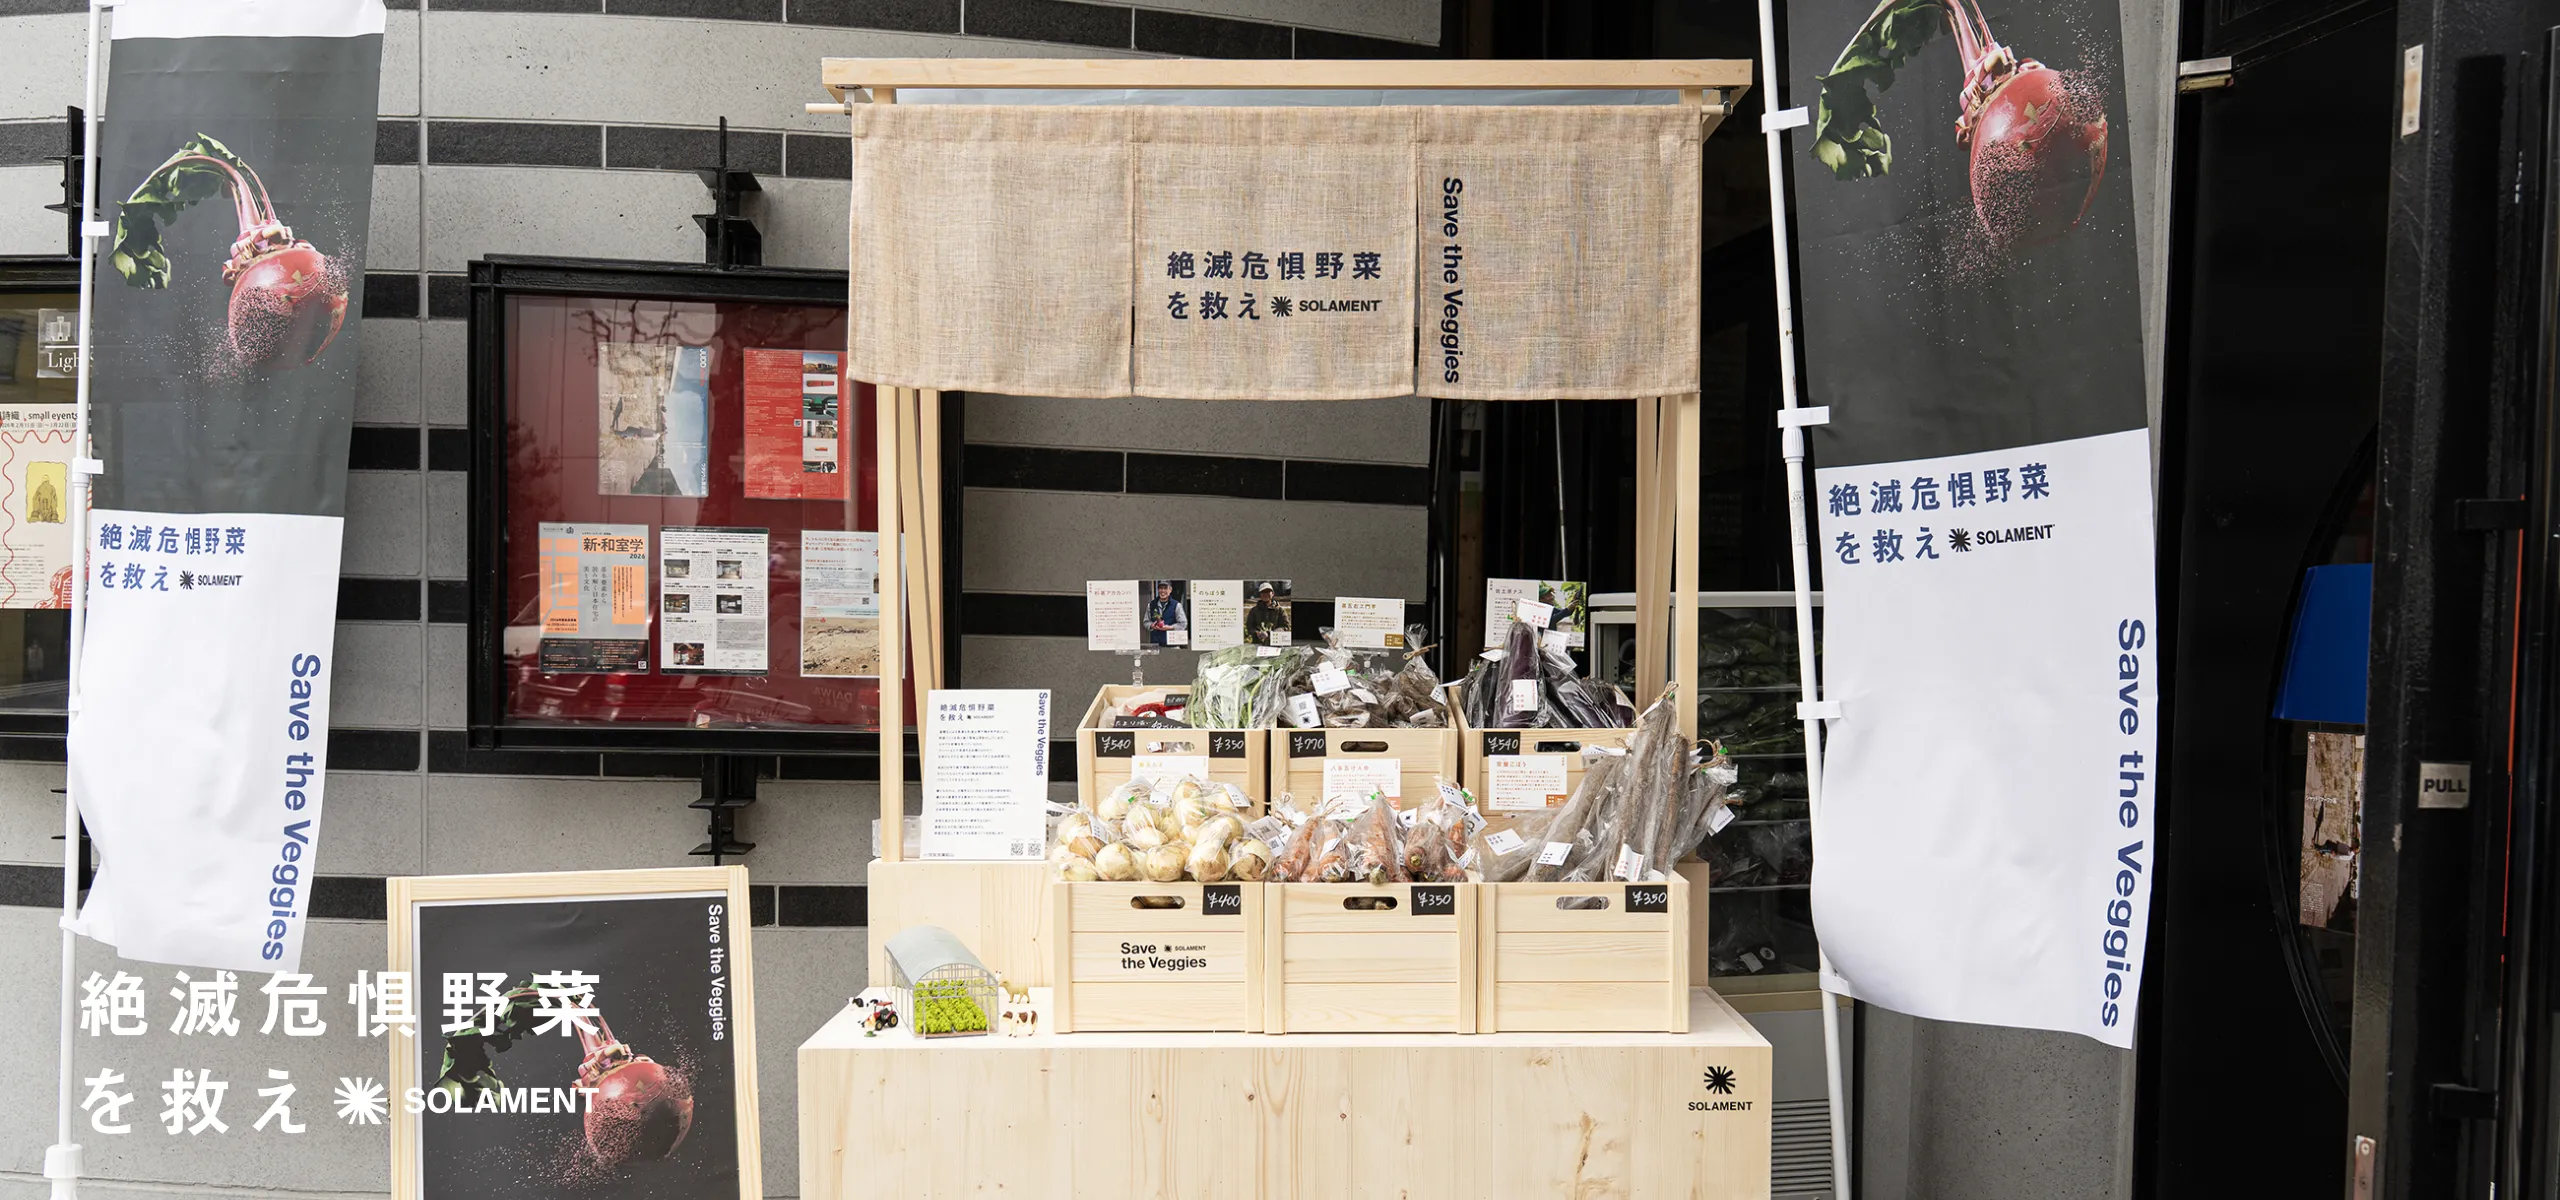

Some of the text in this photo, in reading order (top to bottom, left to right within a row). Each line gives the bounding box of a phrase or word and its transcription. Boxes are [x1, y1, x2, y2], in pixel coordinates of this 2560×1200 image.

[1166, 250, 1382, 281] 絶滅危惧野菜
[1440, 177, 1464, 384] Save the Veggies
[1166, 291, 1380, 320] を救え SOLAMENT
[28, 411, 50, 420] small
[1828, 462, 2050, 518] 絶滅危惧野菜
[99, 523, 246, 556] 絶滅危惧野菜
[1835, 524, 2053, 565] を救え SOLAMENT
[99, 562, 243, 592] を救え SOLAMENT
[1034, 691, 1048, 776] Save the Veggies
[1101, 735, 1132, 753] ¥540
[1213, 736, 1245, 753] ¥350
[1294, 735, 1325, 753] ¥770
[1488, 736, 1519, 752] ¥540
[2423, 778, 2467, 793] PULL
[261, 653, 321, 961] Save the Veggies
[2101, 618, 2146, 1029] Save the Veggies
[1207, 892, 1240, 908] ¥400
[1418, 891, 1452, 907] ¥350
[1632, 890, 1667, 906] ¥350
[1121, 942, 1157, 955] Save
[708, 904, 727, 1041] Save the Veggies
[1121, 956, 1207, 971] the Veggies
[1687, 1101, 1753, 1111] SOLAMENT
